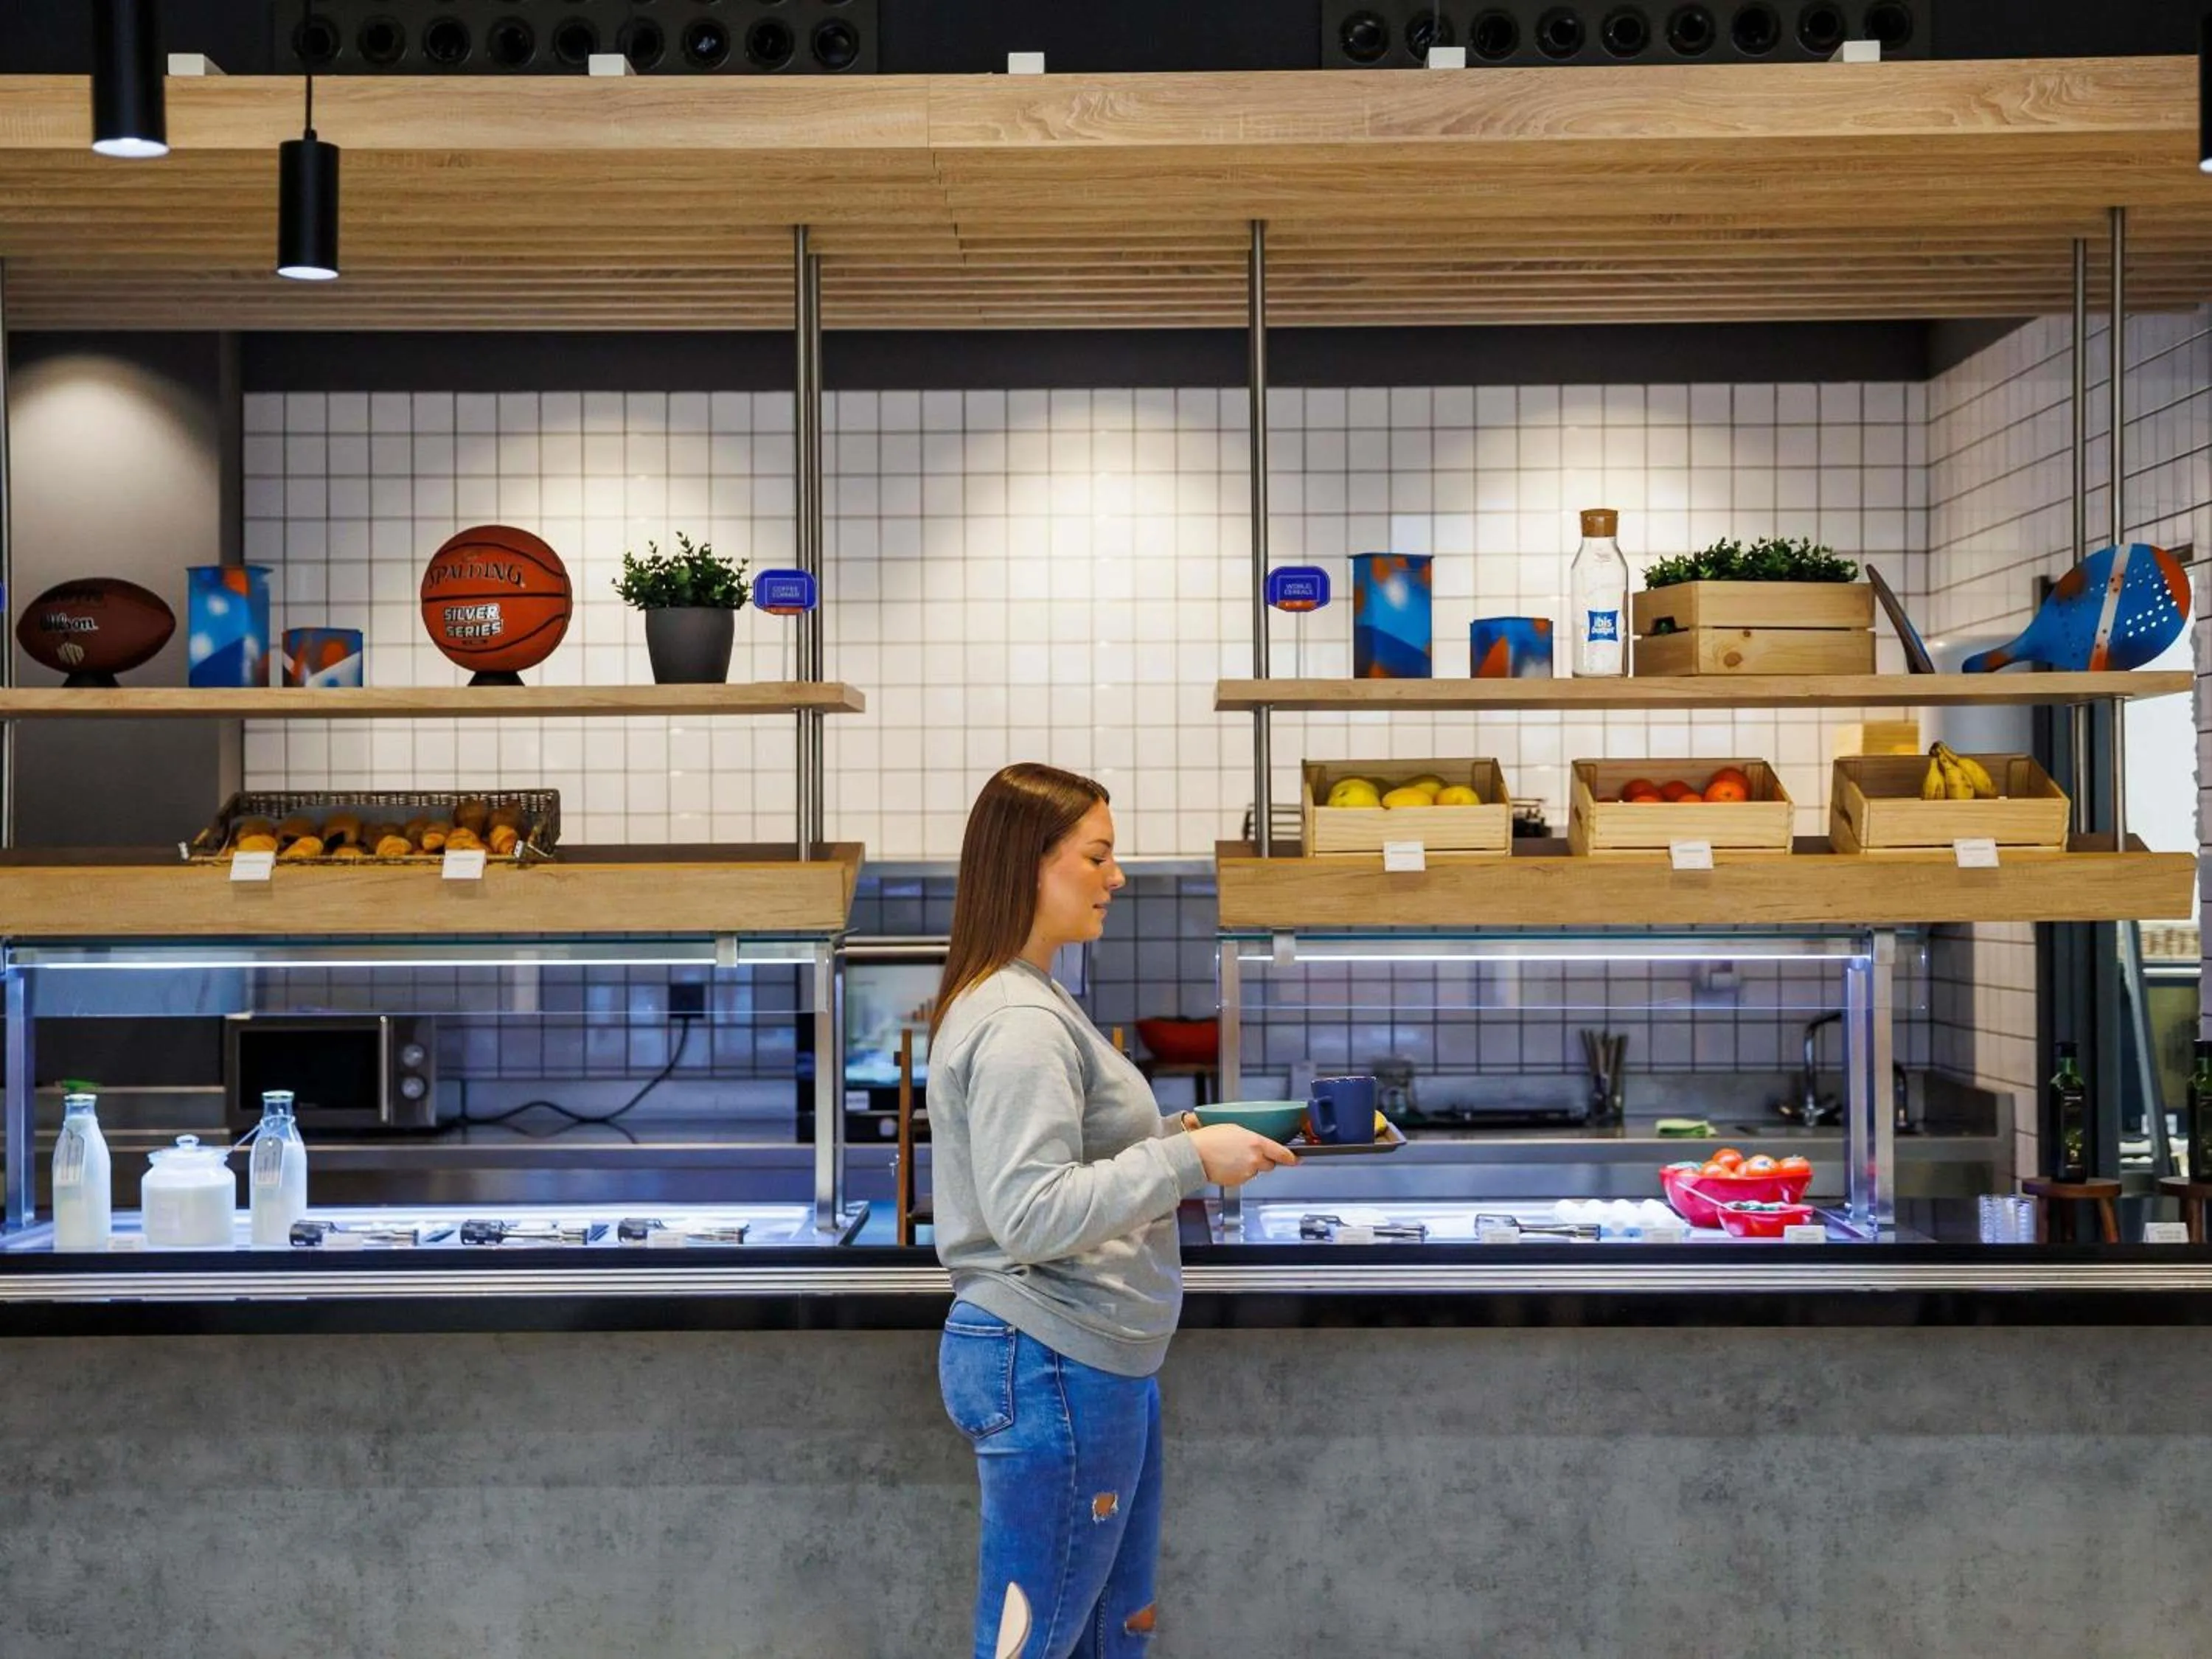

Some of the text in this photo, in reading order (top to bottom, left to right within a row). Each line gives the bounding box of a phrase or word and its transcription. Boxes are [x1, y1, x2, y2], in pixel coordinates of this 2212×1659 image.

[428, 563, 524, 589] SPALDING
[445, 603, 501, 621] SILVER
[446, 622, 503, 639] SERIES
